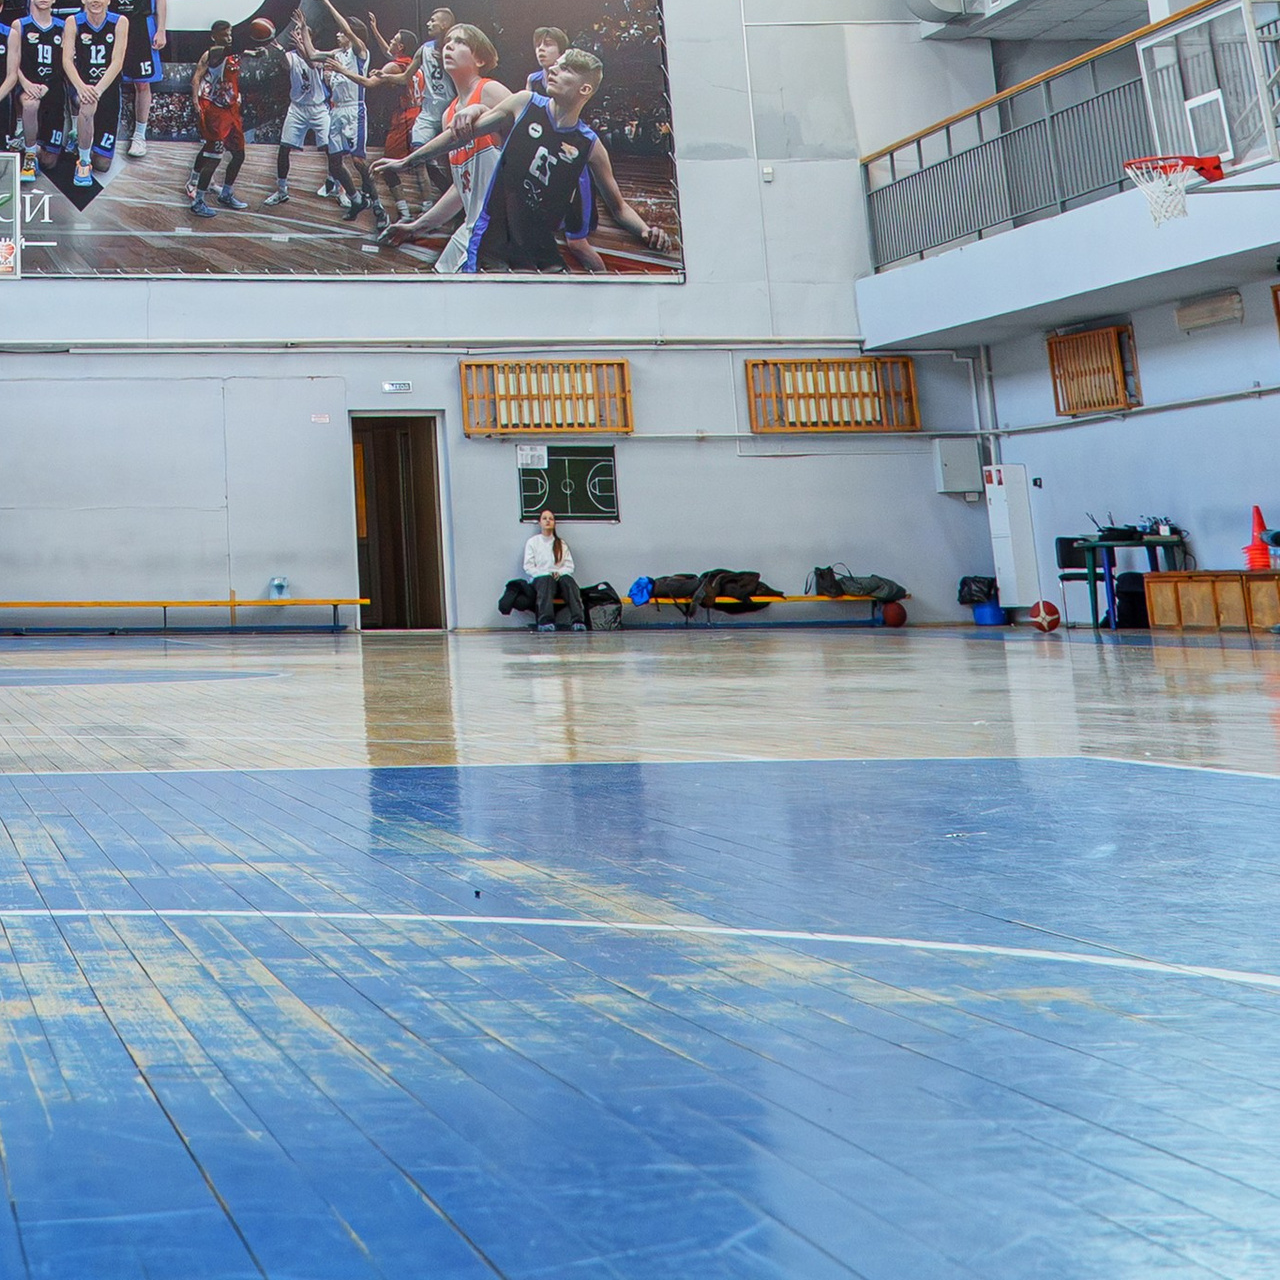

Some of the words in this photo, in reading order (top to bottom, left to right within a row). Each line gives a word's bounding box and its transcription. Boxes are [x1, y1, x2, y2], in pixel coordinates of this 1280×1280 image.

[37, 44, 52, 64] 19
[90, 44, 106, 64] 12
[140, 61, 152, 75] 15
[50, 130, 63, 145] 19
[100, 132, 115, 149] 12
